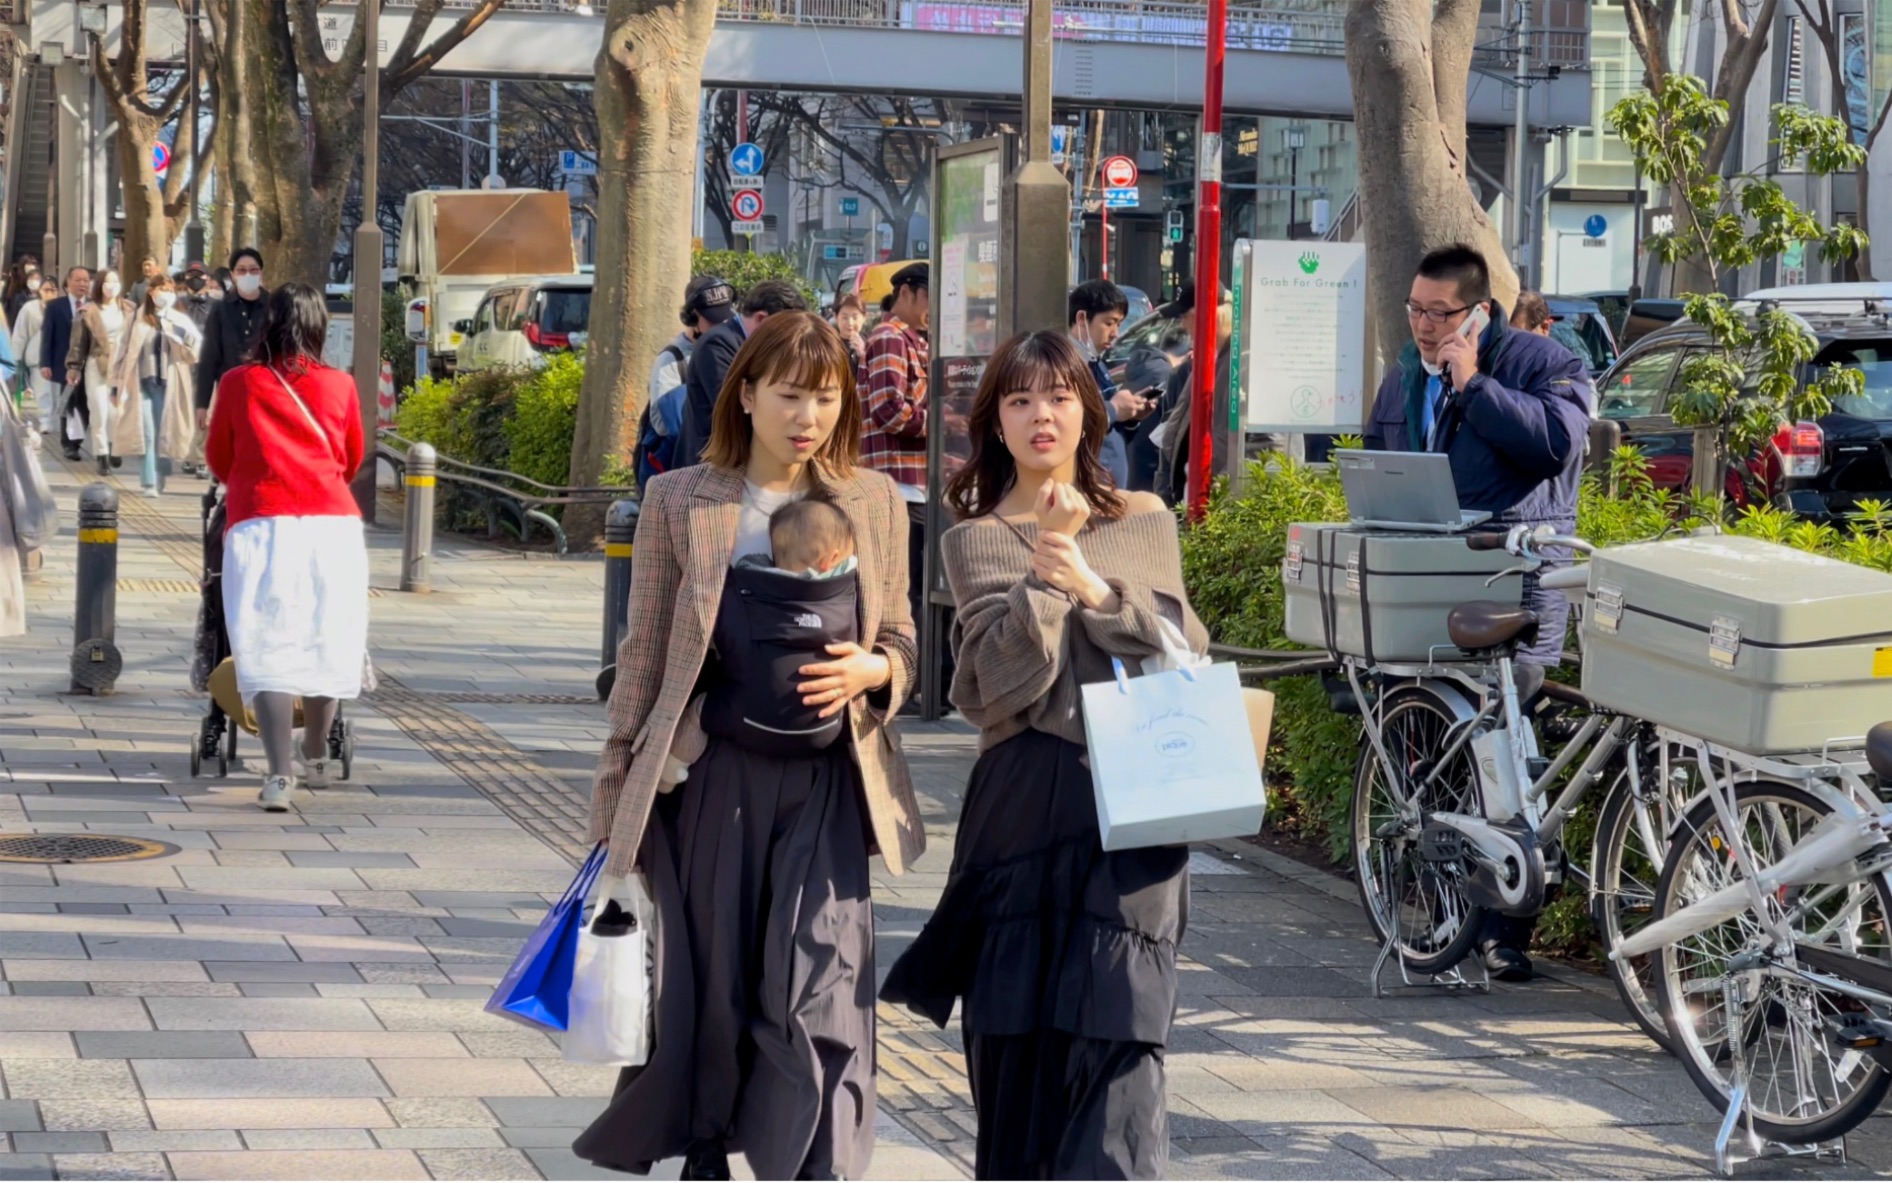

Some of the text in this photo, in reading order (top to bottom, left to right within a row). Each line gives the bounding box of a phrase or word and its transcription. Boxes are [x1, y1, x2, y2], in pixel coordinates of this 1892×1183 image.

[1261, 277, 1288, 288] Grab
[1294, 278, 1310, 288] For
[1315, 278, 1349, 288] Green
[1231, 282, 1241, 414] moking Area
